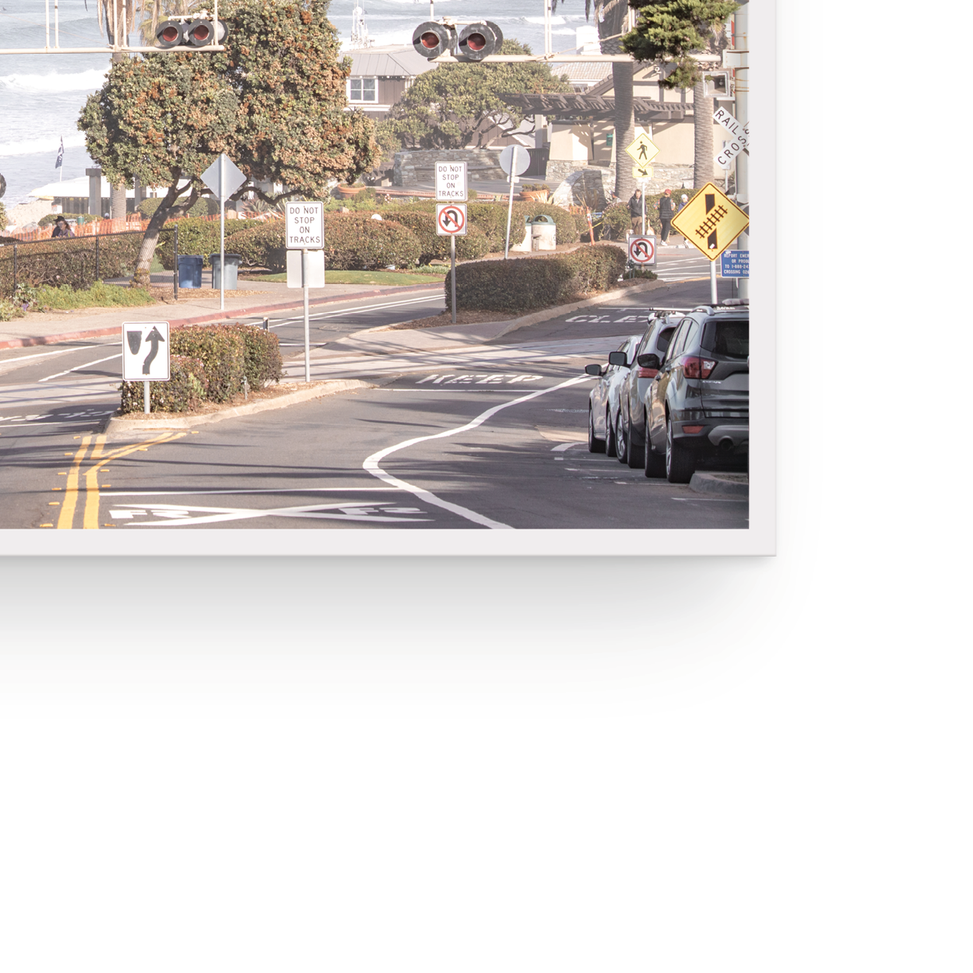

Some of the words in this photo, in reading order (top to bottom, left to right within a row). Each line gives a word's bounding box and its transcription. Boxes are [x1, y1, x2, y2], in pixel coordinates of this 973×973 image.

[715, 110, 739, 136] RAIL
[438, 165, 447, 173] DO
[449, 165, 462, 173] NOT
[289, 206, 301, 215] DO
[303, 206, 319, 215] NOT
[294, 216, 315, 224] STOP
[299, 226, 310, 234] ON
[289, 235, 321, 244] TRACKS
